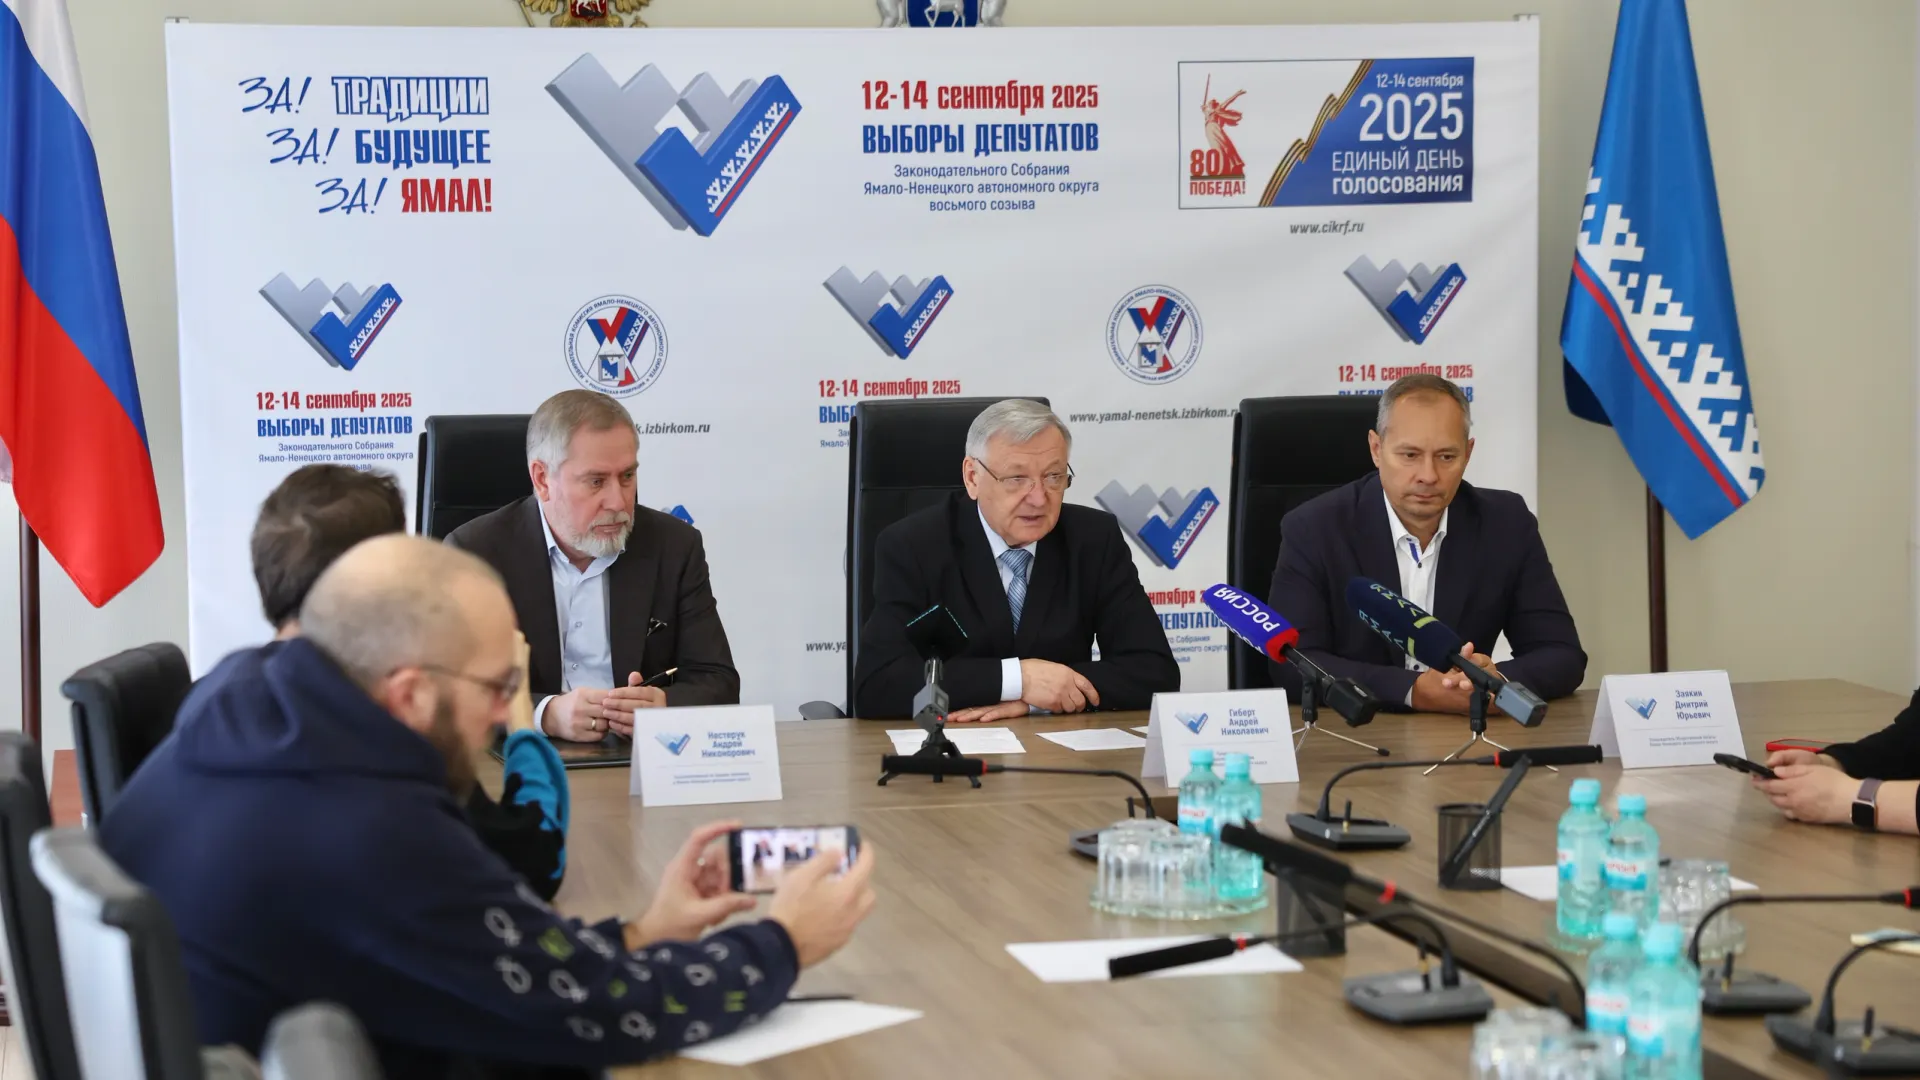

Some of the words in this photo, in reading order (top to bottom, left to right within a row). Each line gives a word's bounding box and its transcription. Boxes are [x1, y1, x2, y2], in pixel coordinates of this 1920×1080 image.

[1376, 74, 1406, 88] 12-14
[1407, 73, 1464, 90] сентября
[238, 76, 312, 114] ЗА!
[331, 76, 489, 123] ТРАДИЦИИ
[862, 80, 928, 110] 12-14
[938, 80, 1044, 116] сентября
[1052, 85, 1099, 109] 2025
[1359, 92, 1464, 142] 2025
[266, 127, 340, 165] ЗА!
[355, 129, 491, 170] БУДУЩЕЕ
[862, 124, 965, 154] ВЫБОРЫ
[974, 123, 1099, 158] ДЕПУТАТОВ
[1190, 149, 1223, 176] 80
[1332, 147, 1410, 173] ЕДИНЫЙ
[1415, 149, 1464, 171] ДЕНЬ
[894, 164, 1007, 178] Законодательного
[1011, 163, 1070, 178] Собрания
[864, 181, 974, 196] Ямало-Ненецкого
[977, 182, 1055, 194] автономного
[1059, 181, 1099, 195] округа
[1190, 181, 1246, 197] ПОБЕДА!
[1332, 175, 1464, 195] голосования
[315, 177, 388, 214] ЗА!
[401, 178, 492, 213] ЯМАЛ!
[929, 200, 986, 211] восьмого
[990, 200, 1036, 211] созыва
[1290, 220, 1364, 235] www.cikrf.ru
[571, 306, 593, 333] КОМИССИЯ
[1338, 364, 1376, 382] 12-14
[1446, 364, 1473, 379] 2025
[818, 379, 858, 398] 12-14
[864, 378, 928, 399] сентября
[932, 380, 961, 395] 2025
[256, 391, 300, 410] 12-14
[306, 390, 376, 412] сентября
[381, 393, 412, 408] 2025
[257, 418, 325, 437] ВЫБОРЫ
[331, 416, 413, 438] ДЕПУТАТОВ
[278, 442, 353, 452] Законодательного
[355, 441, 394, 451] Собрания
[258, 453, 331, 463] Ямало-Ненецкого
[333, 453, 385, 462] автономного
[387, 452, 414, 461] округа
[1213, 587, 1281, 633] РОССИЯ
[1675, 690, 1702, 698] Заякин
[1229, 708, 1255, 717] Гиберт
[1675, 700, 1708, 710] Дмитрий
[1229, 717, 1258, 726] Андрей
[1676, 711, 1711, 720] Юрьевич
[707, 731, 745, 740] Нестерук
[1221, 727, 1269, 736] Николаевич
[712, 740, 742, 748] Андрей
